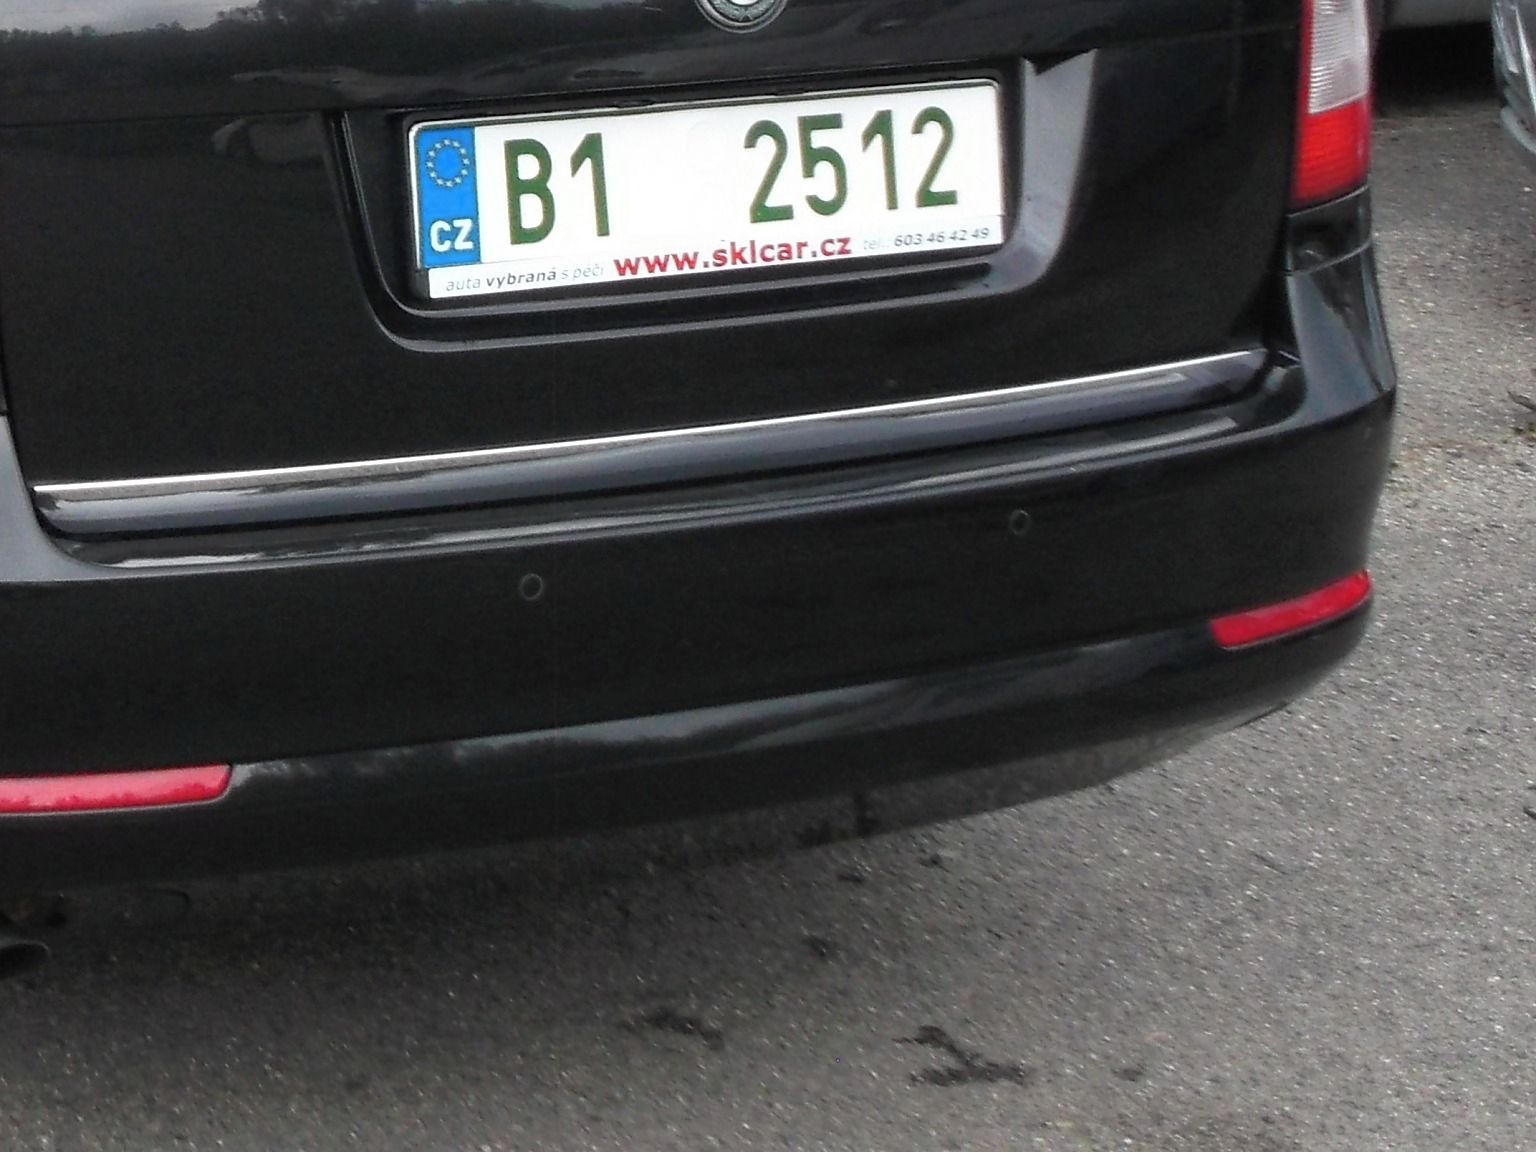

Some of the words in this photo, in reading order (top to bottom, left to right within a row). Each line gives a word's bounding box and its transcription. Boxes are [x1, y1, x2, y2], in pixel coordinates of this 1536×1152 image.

[504, 132, 610, 245] B1
[743, 105, 959, 224] 2512
[429, 218, 474, 253] CZ
[446, 277, 481, 292] auta
[486, 266, 557, 289] vybraná
[614, 237, 852, 277] www.sklcar.cz
[894, 233, 923, 247] 603
[949, 229, 967, 241] 42
[971, 227, 990, 239] 49
